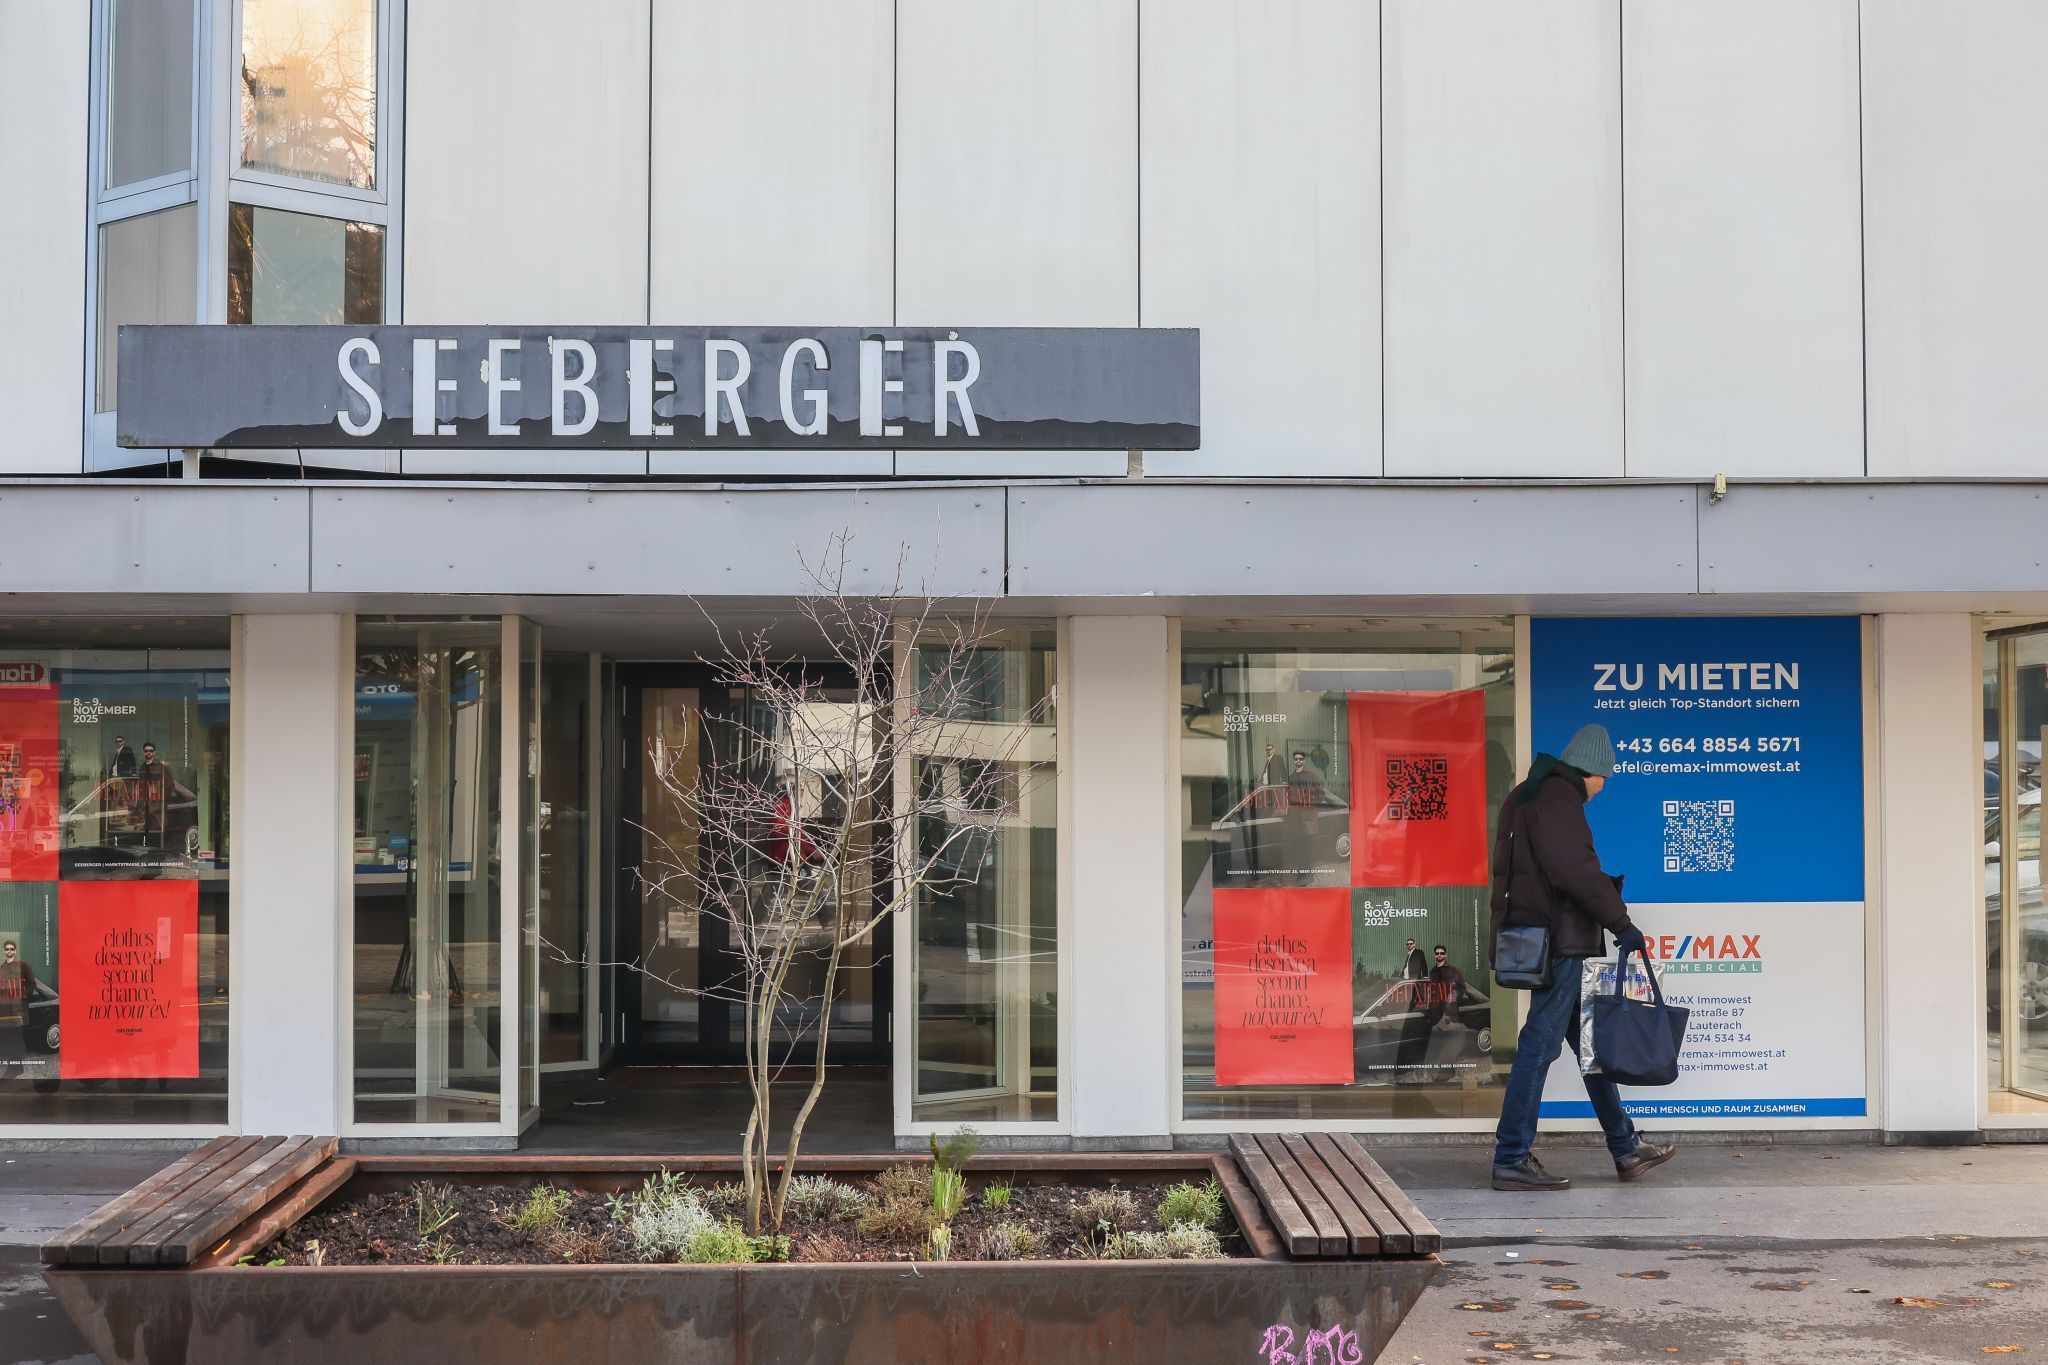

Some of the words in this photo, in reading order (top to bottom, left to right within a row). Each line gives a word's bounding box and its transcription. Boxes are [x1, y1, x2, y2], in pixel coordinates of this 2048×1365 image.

[337, 338, 980, 436] SEEBERGER
[1593, 663, 1644, 691] ZU
[1658, 662, 1799, 691] MIETEN
[73, 697, 83, 706] 8.
[92, 697, 102, 706] 9.
[1594, 698, 1625, 709] Jetzt
[1629, 698, 1666, 710] gleich
[1670, 697, 1752, 710] Top-Standort
[1755, 697, 1800, 708] sichern
[73, 706, 136, 715] NOVEMBER
[1223, 706, 1233, 715] 8.
[1243, 706, 1253, 715] 9.
[73, 715, 99, 723] 2025
[1223, 714, 1287, 723] NOVEMBER
[1223, 723, 1249, 732] 2025
[1616, 738, 1653, 753] +43
[1658, 737, 1697, 753] 664
[1702, 737, 1751, 753] 8854
[1757, 737, 1800, 752] 5671
[1612, 760, 1800, 776] efel@remax-immowest.at
[1364, 900, 1374, 909] 8.
[1383, 900, 1393, 909] 9.
[1364, 908, 1428, 918] NOVEMBER
[1364, 917, 1390, 926] 2025
[104, 927, 154, 947] clothes
[1257, 934, 1307, 954] clothes
[1636, 934, 1762, 960] RE/MAX
[95, 946, 152, 966] deserve
[153, 951, 162, 966] a
[1248, 953, 1305, 973] deserve
[1307, 957, 1316, 973] a
[1665, 963, 1759, 972] MMERCIAL
[102, 963, 154, 984] second
[1257, 970, 1308, 991] second
[101, 982, 157, 1003] chance,
[1255, 986, 1311, 1009] chance,
[1664, 994, 1694, 1005] /MAX
[1697, 995, 1752, 1005] Immowest
[1689, 1008, 1729, 1018] sstraße
[1731, 1008, 1745, 1017] 87
[1689, 1020, 1742, 1030] Lauterach
[1686, 1033, 1711, 1043] 5574
[1714, 1033, 1735, 1043] 534
[1738, 1033, 1751, 1042] 34
[1679, 1049, 1786, 1059] remax-immowest.at
[1677, 1061, 1768, 1072] max-immowest.at
[1622, 1104, 1657, 1114] ÜHREN
[1660, 1105, 1699, 1114] MENSCH
[1701, 1105, 1722, 1113] UND
[1724, 1105, 1751, 1113] RAUM
[1753, 1104, 1806, 1113] ZUSAMMEN
